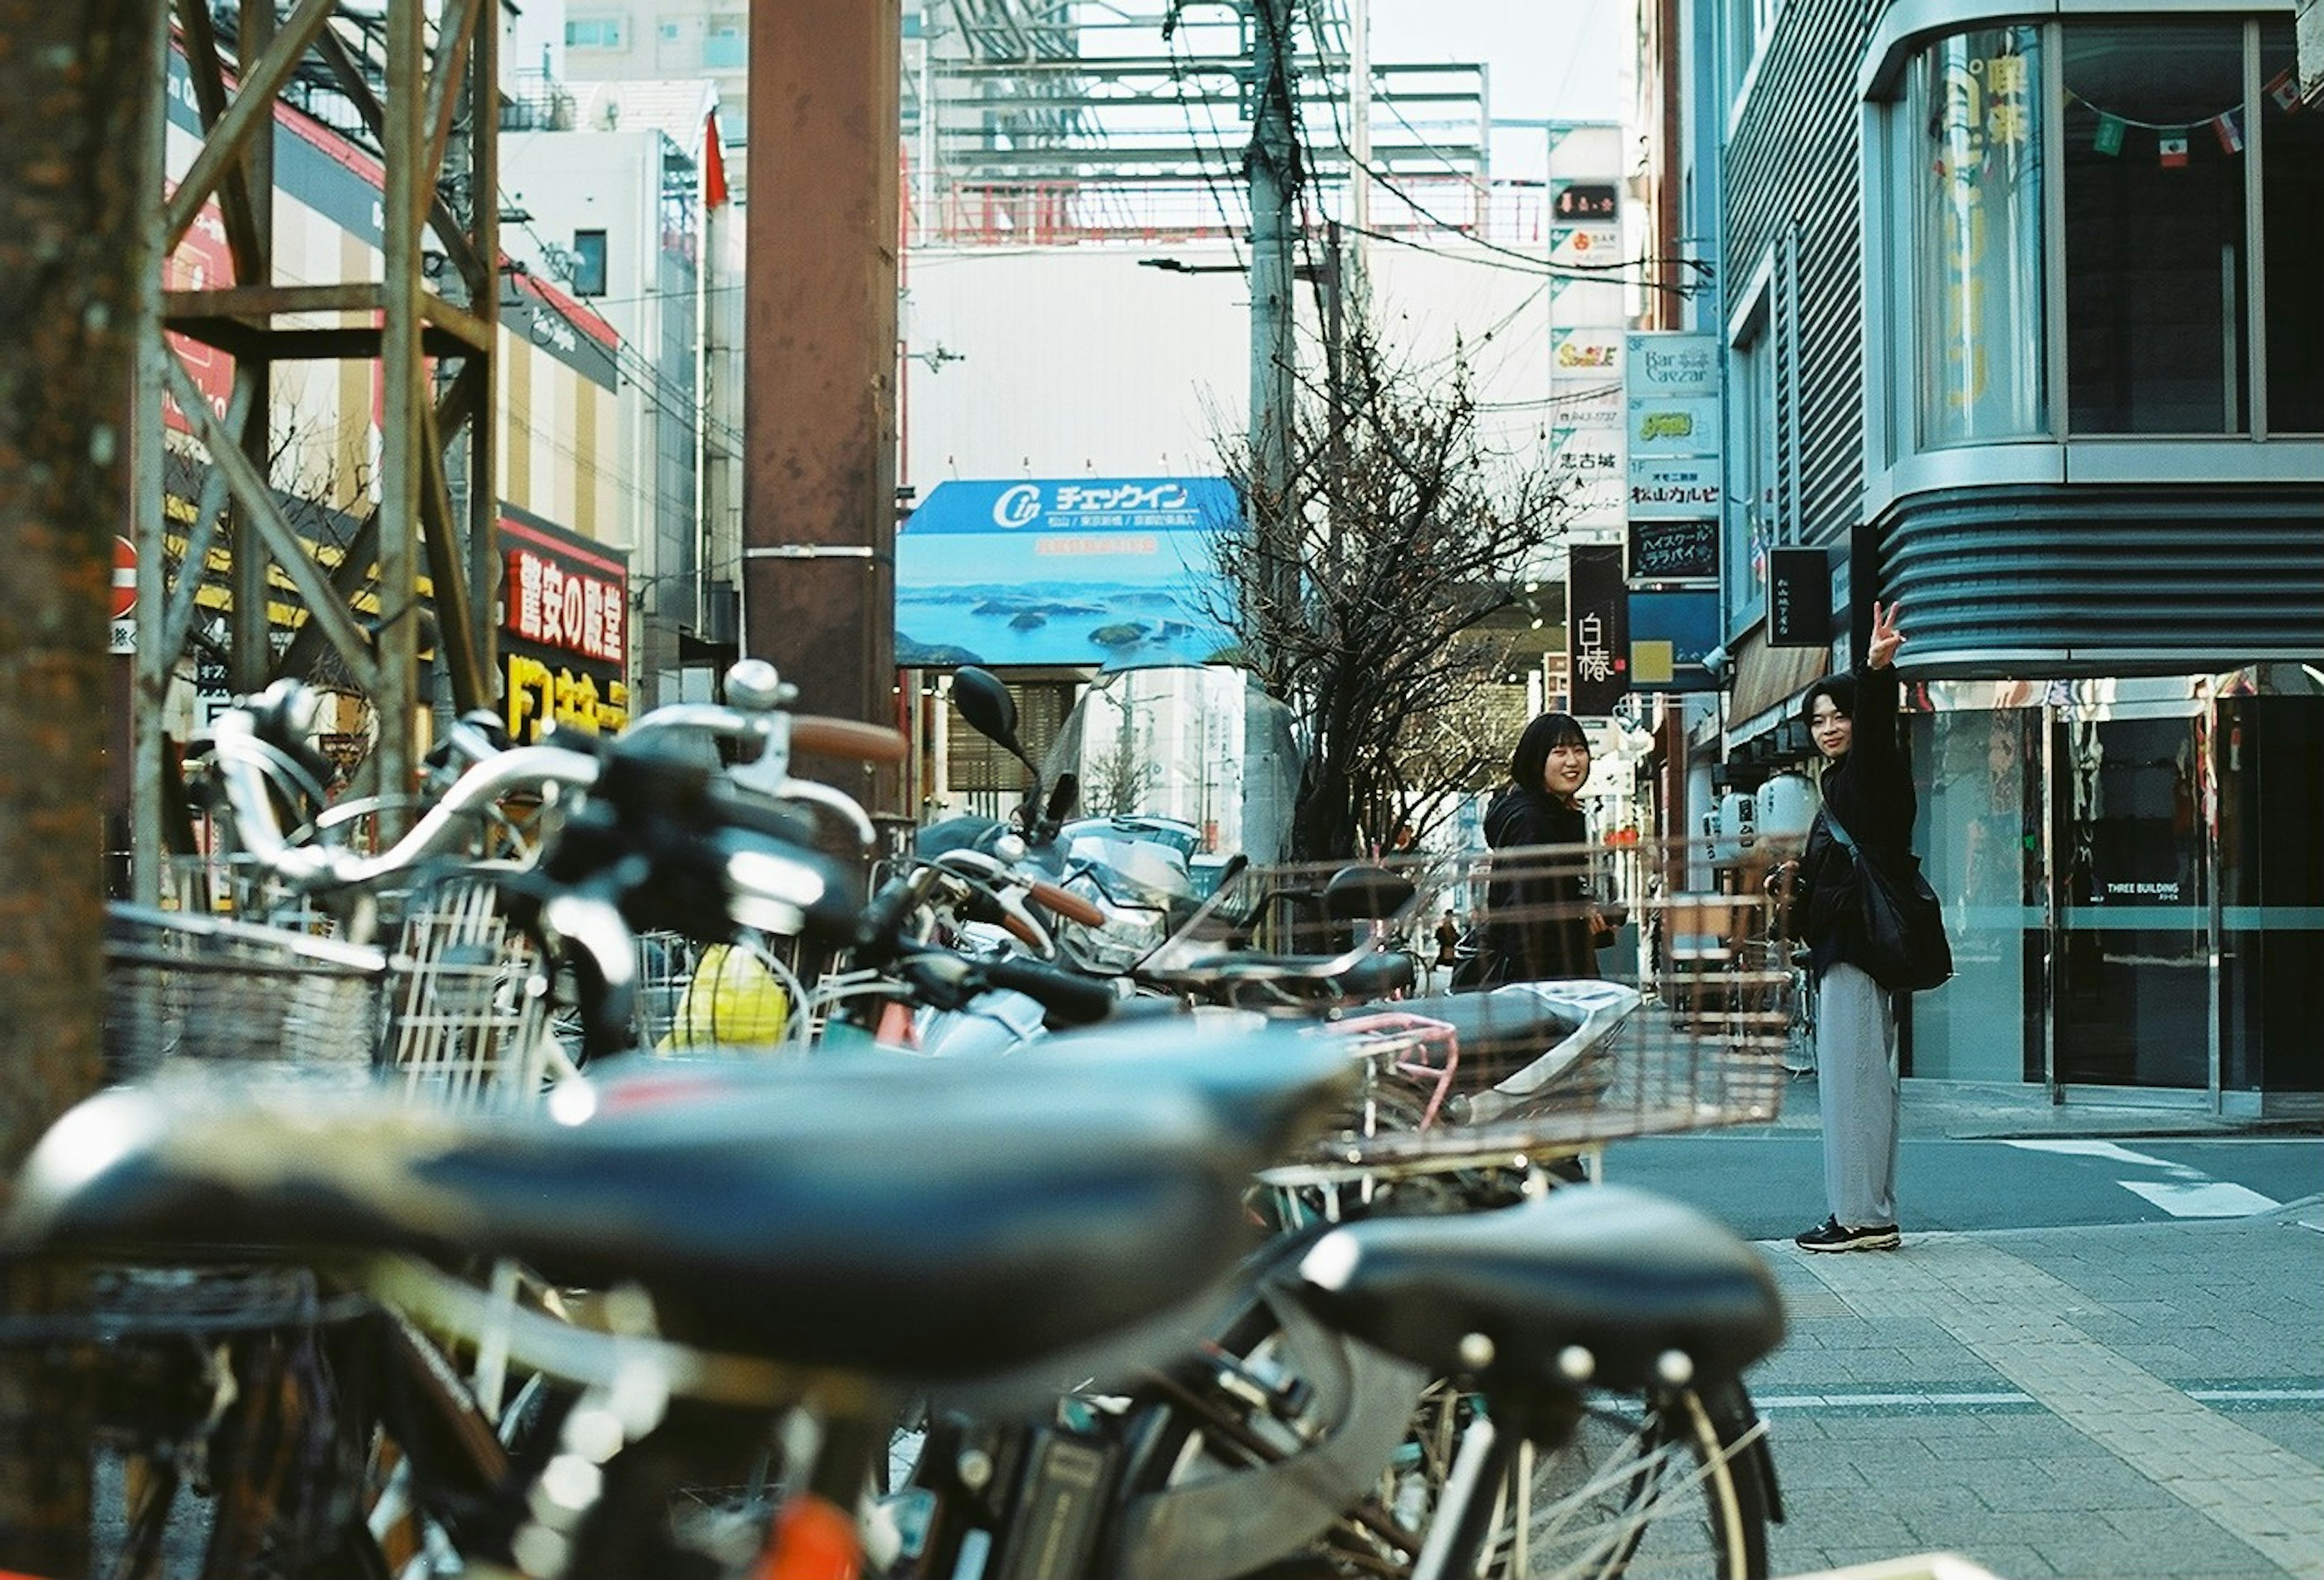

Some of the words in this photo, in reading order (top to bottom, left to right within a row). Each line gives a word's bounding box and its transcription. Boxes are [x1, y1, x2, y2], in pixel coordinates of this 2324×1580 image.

[1646, 352, 1675, 369] Bar
[1056, 484, 1188, 510] チェックイン
[1630, 485, 1720, 505] 松山カルビ
[519, 551, 622, 661] 驚安の殿堂
[1575, 612, 1615, 682] 白椿
[2107, 883, 2135, 894] THREE
[2136, 883, 2179, 894] BUILDING
